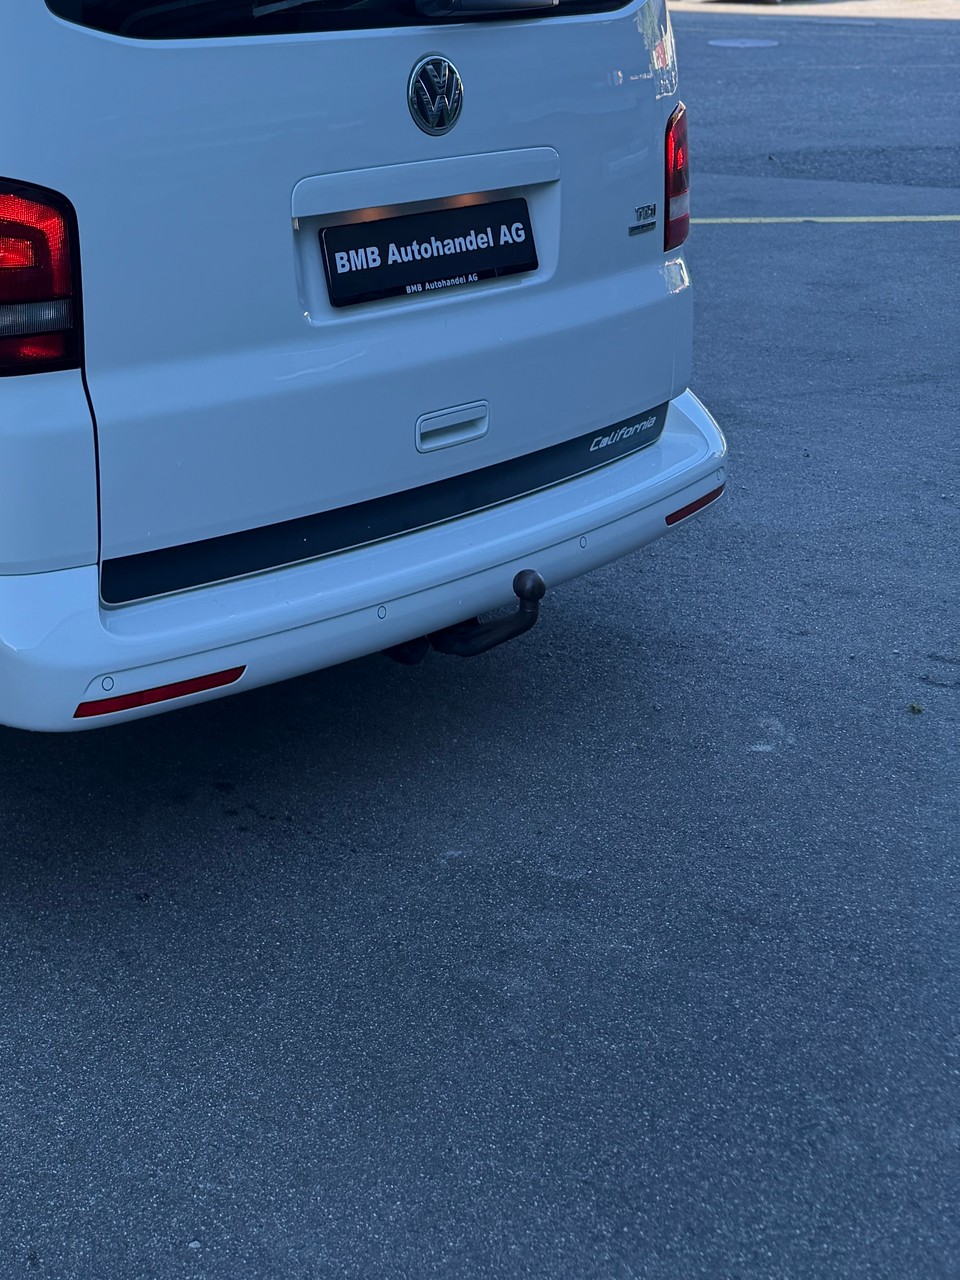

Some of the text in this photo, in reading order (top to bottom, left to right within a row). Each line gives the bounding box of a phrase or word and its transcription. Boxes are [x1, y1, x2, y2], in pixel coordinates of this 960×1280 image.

[334, 222, 526, 274] BMB Autohandel AG
[405, 273, 479, 294] BMB Autohandel AG
[589, 416, 657, 452] California
